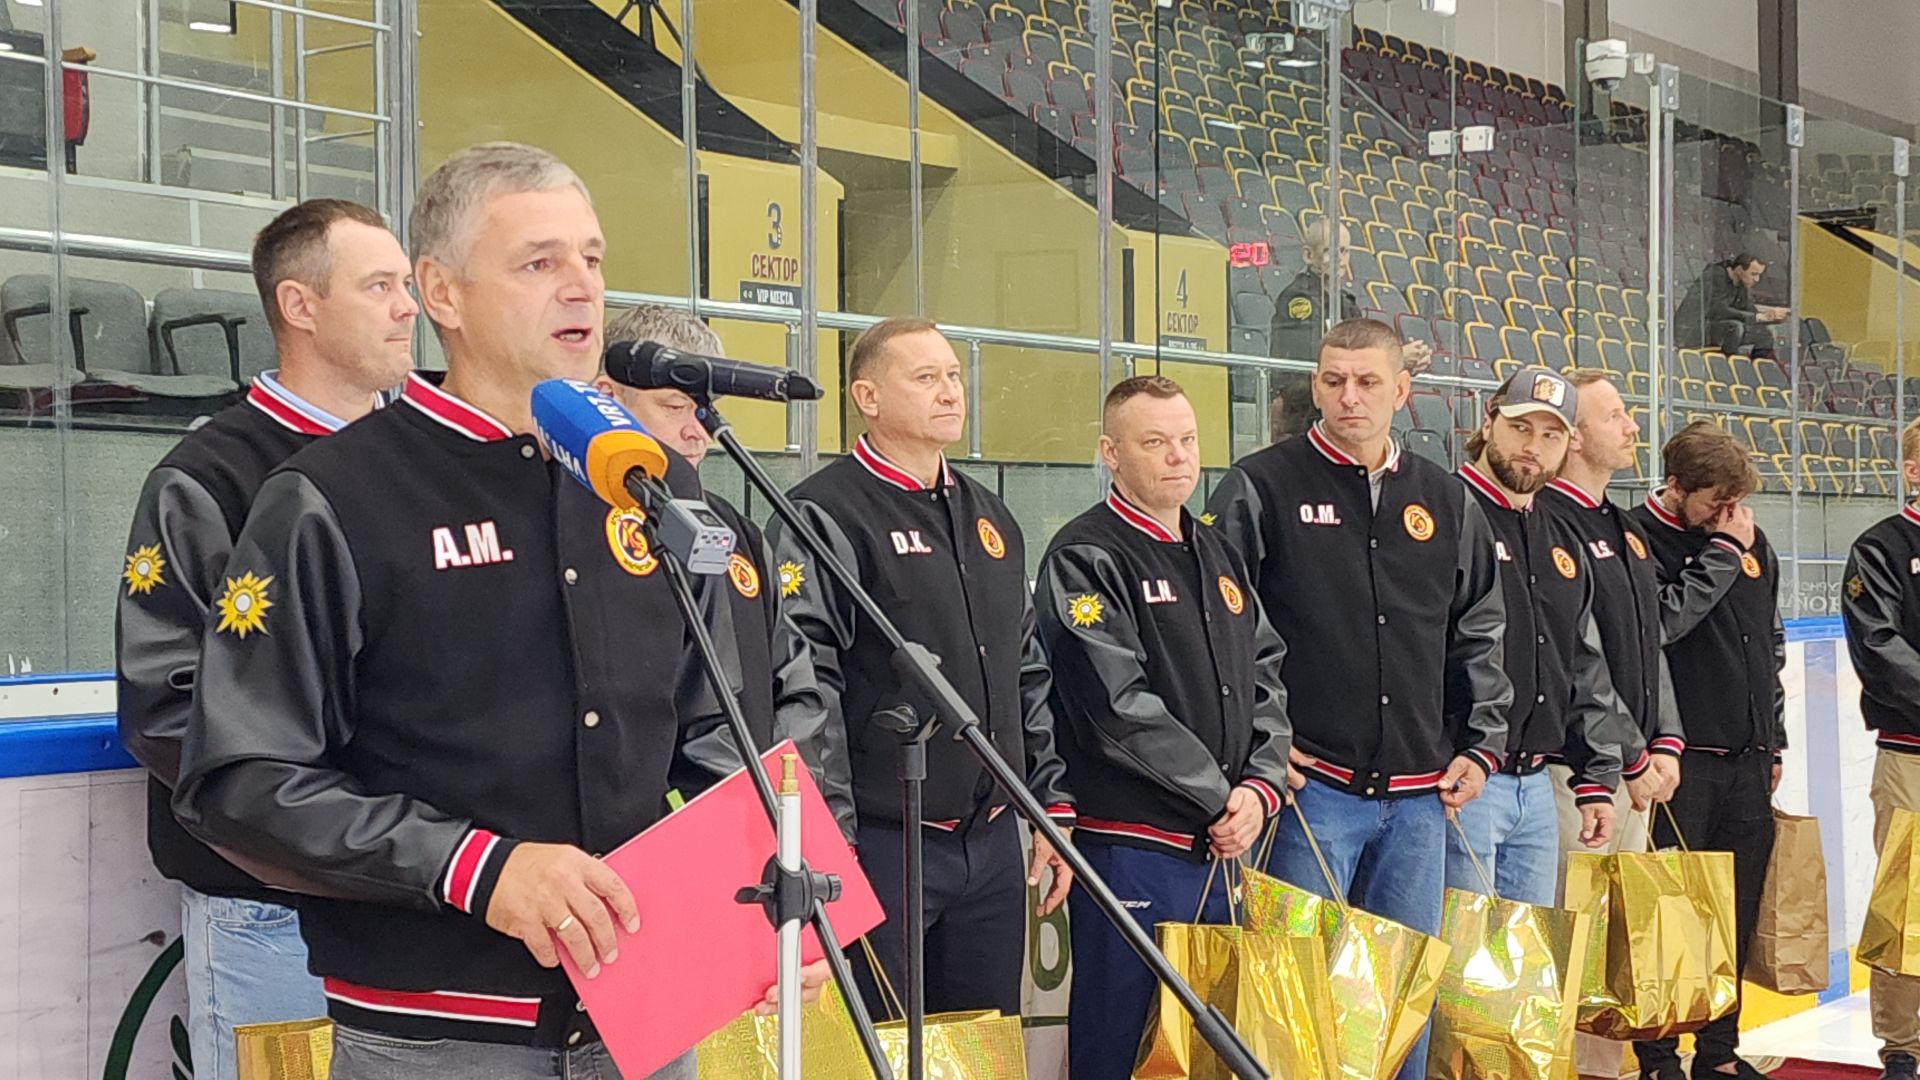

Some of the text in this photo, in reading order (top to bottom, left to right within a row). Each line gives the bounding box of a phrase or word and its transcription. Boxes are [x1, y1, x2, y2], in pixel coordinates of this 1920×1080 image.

[767, 202, 782, 250] 3
[751, 254, 798, 282] СЕКТОР
[756, 288, 795, 306] VIP МЕСТА
[1176, 268, 1188, 309] 4
[1167, 311, 1199, 334] СЕКТОР
[1299, 503, 1342, 526] O.M.
[432, 520, 514, 571] A.M.
[890, 530, 933, 555] D.K.
[1141, 579, 1178, 603] L.N.
